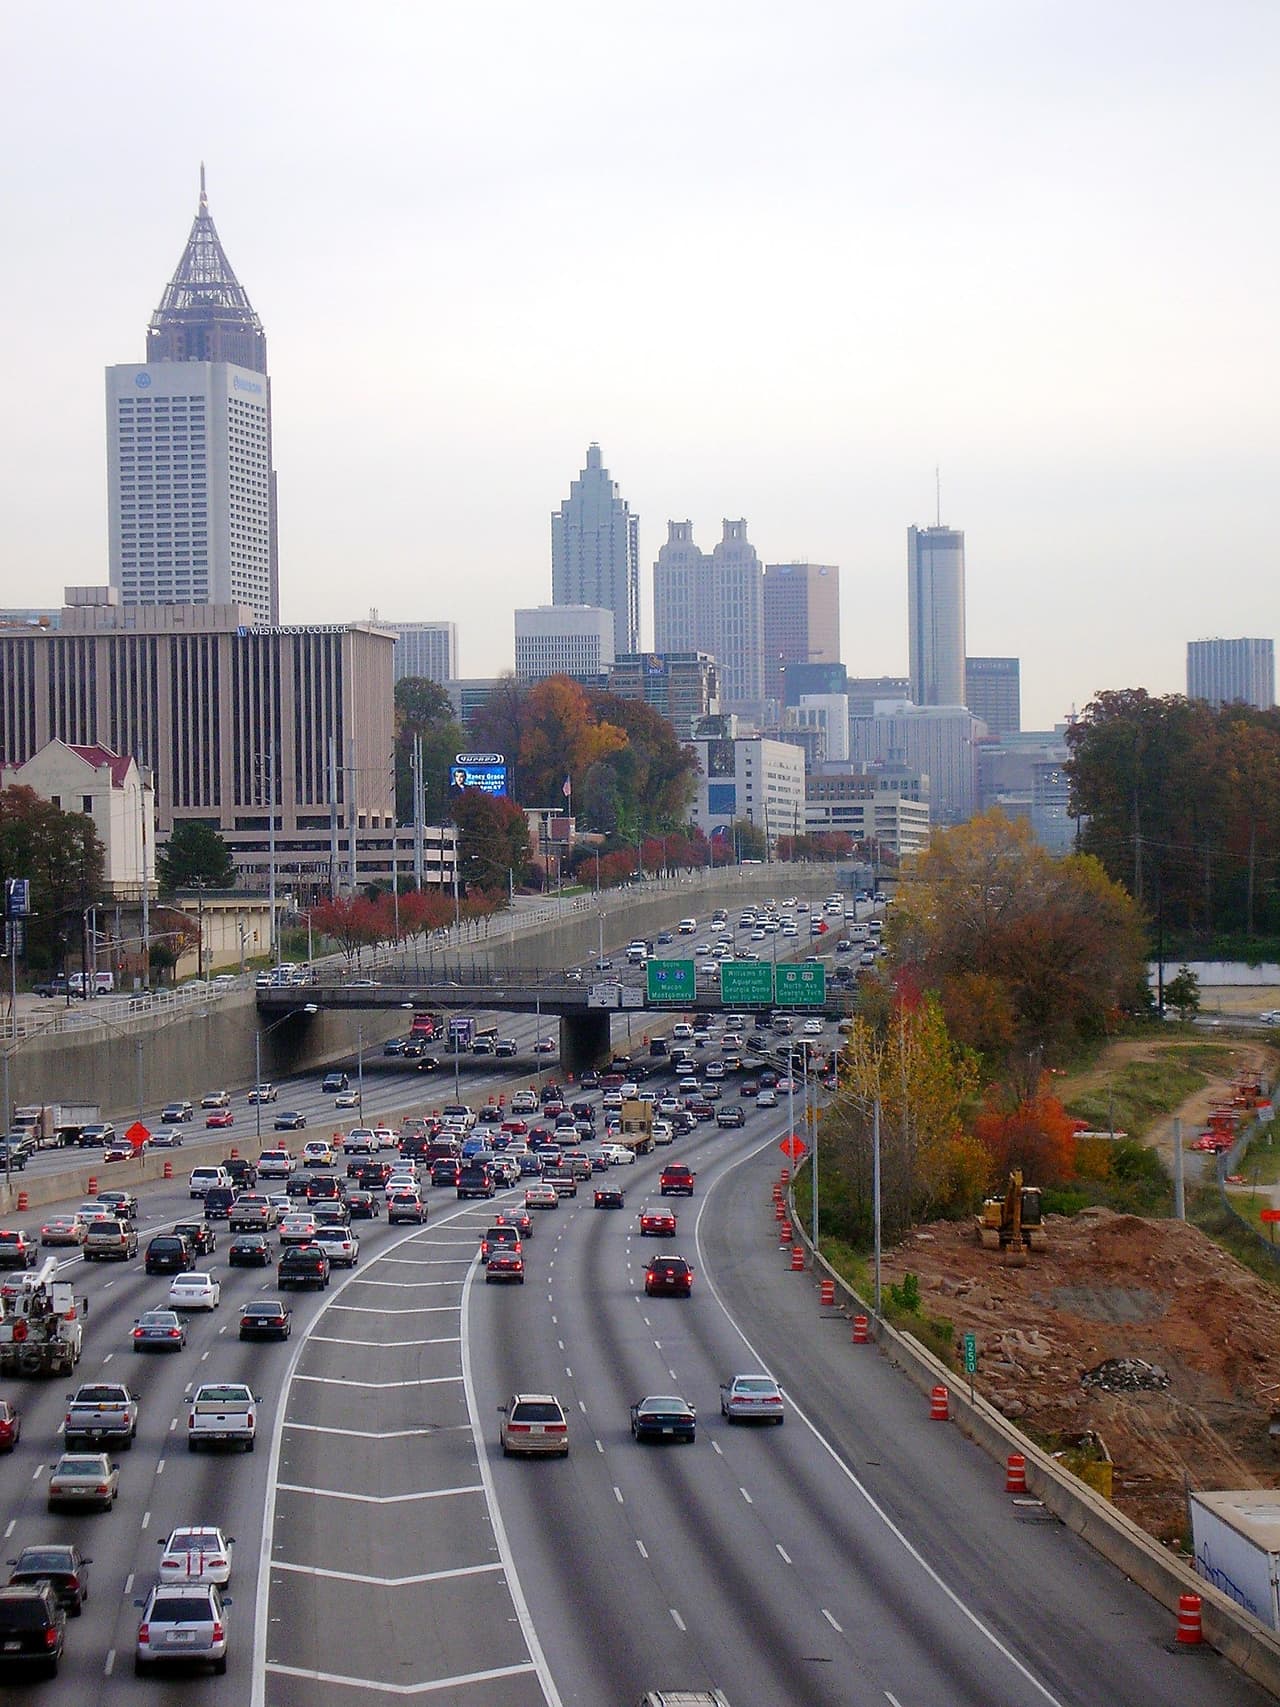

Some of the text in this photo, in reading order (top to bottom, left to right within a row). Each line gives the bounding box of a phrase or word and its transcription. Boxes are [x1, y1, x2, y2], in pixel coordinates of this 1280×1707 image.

[249, 625, 305, 635] WESTWOOD
[306, 624, 349, 634] COLLEGE
[651, 992, 692, 1000] Montgomery
